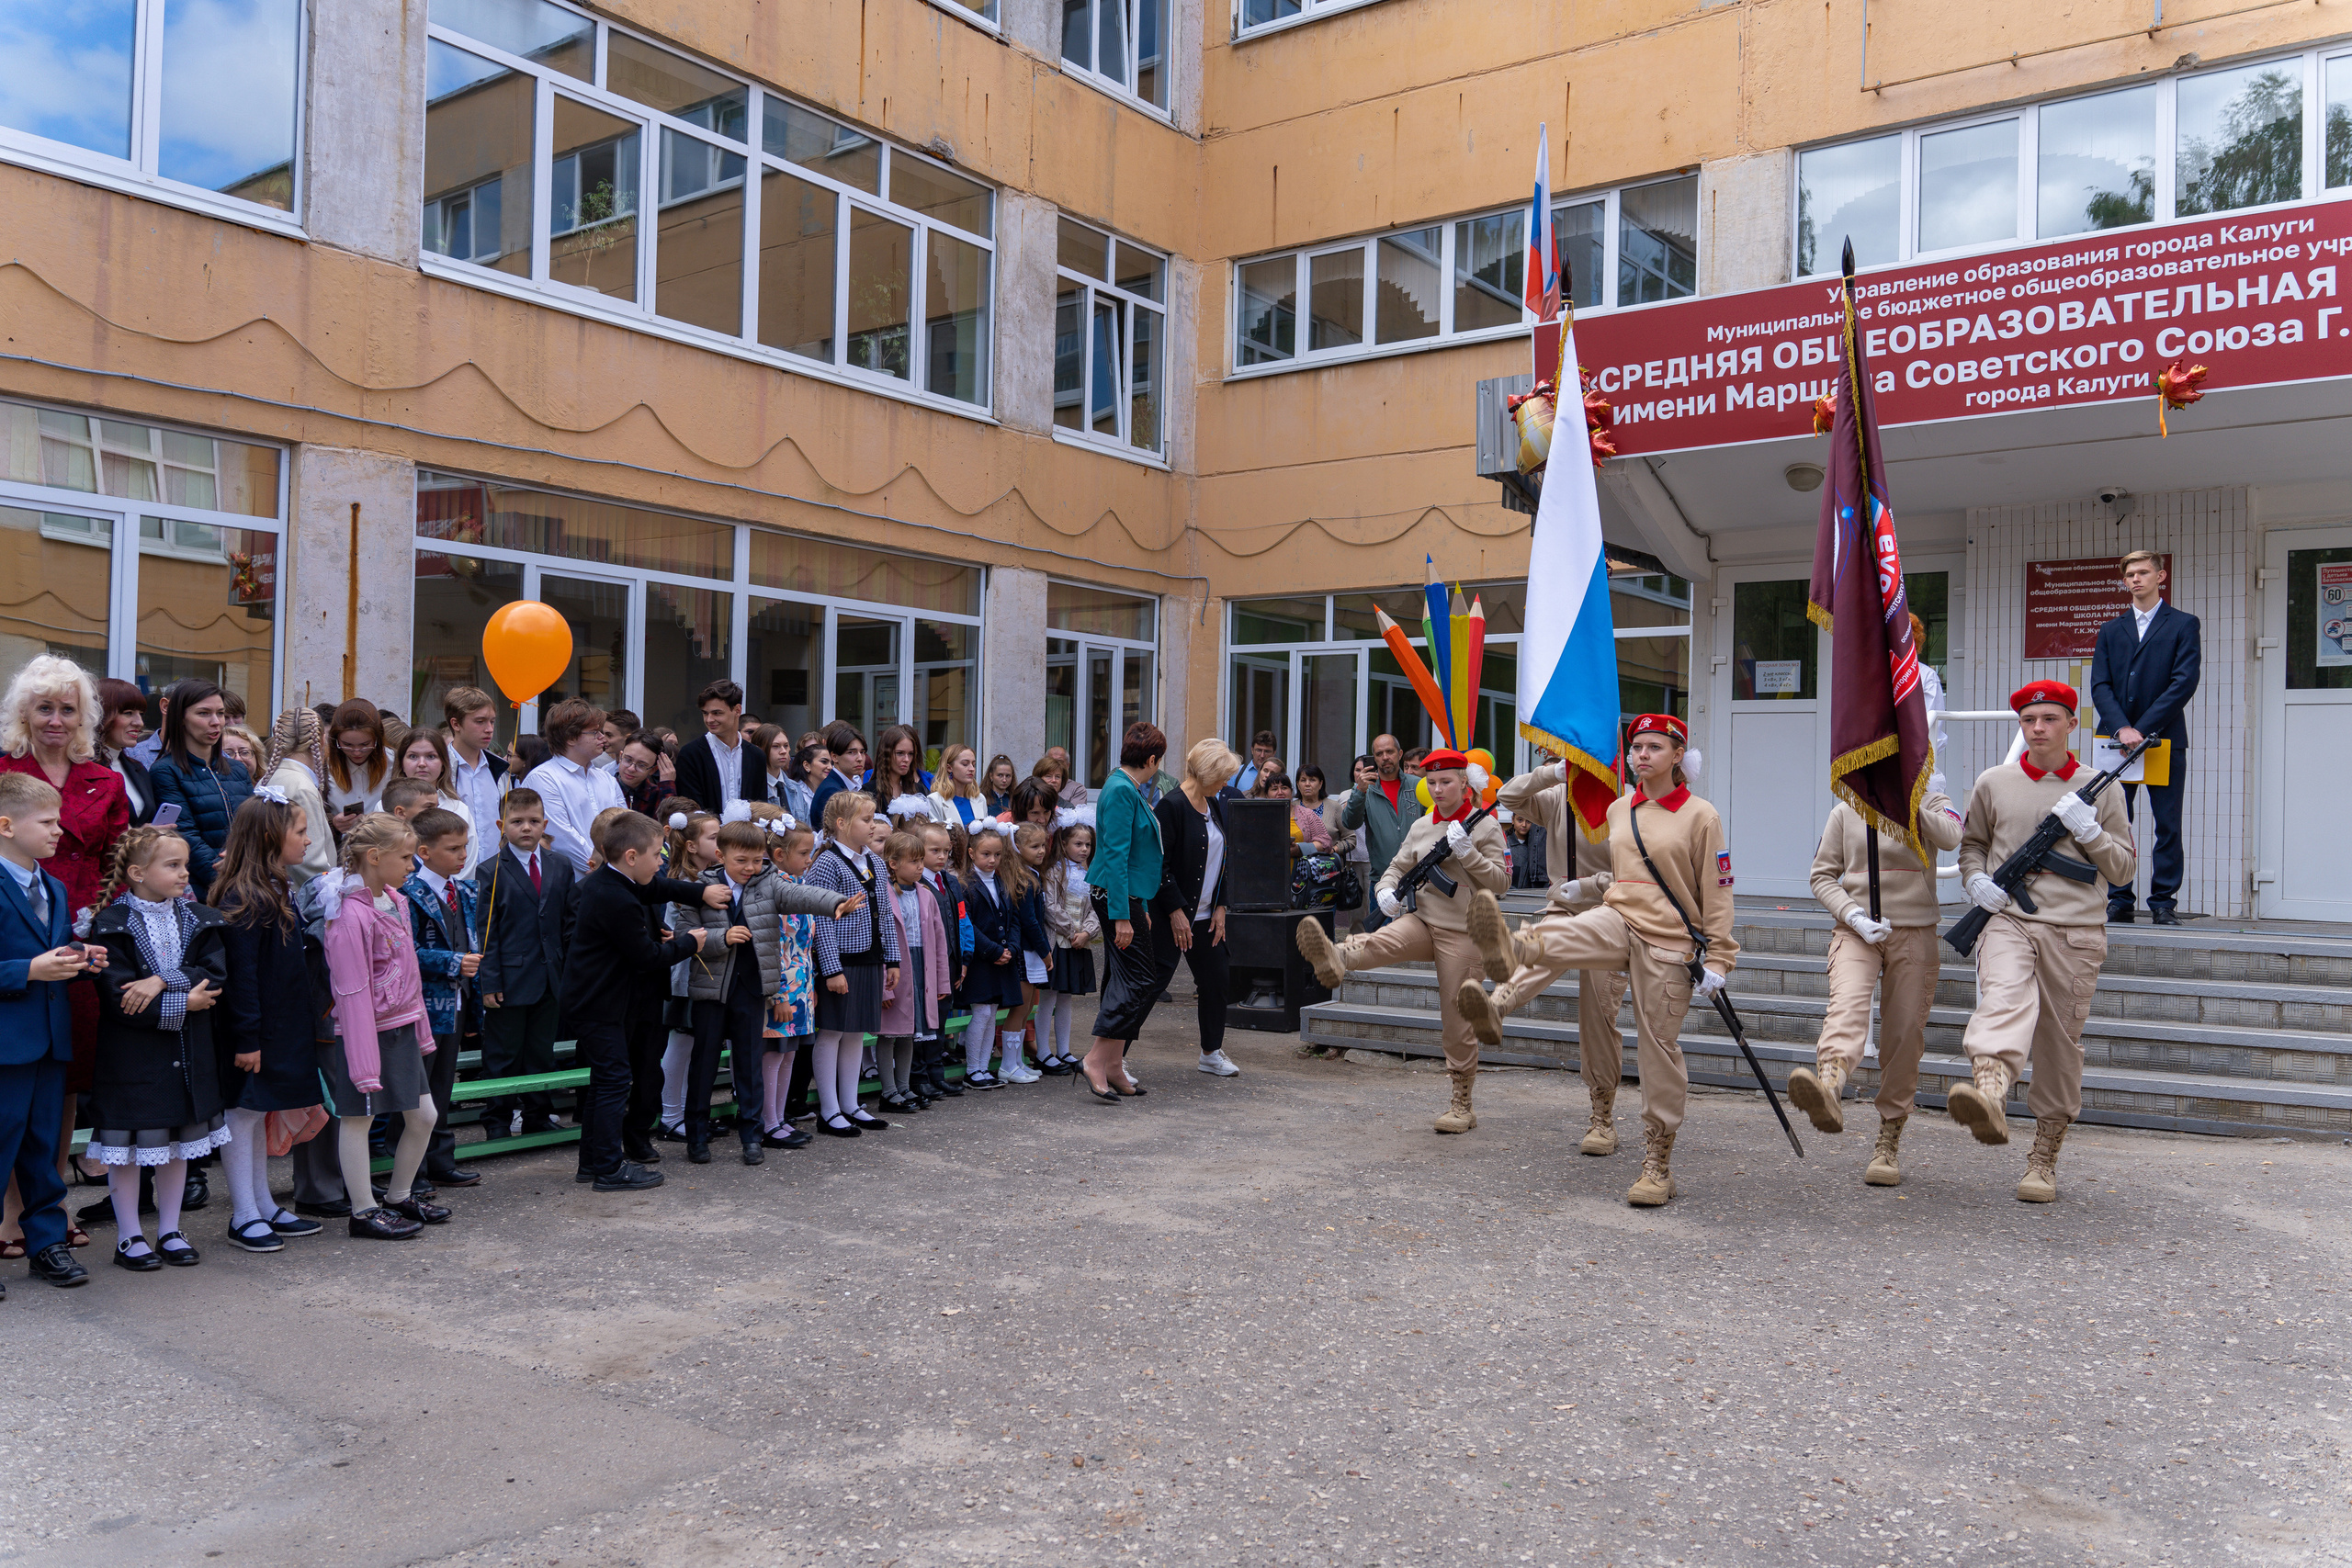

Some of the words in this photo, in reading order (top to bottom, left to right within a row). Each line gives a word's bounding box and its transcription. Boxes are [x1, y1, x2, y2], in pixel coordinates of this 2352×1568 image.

[1964, 247, 2119, 286] образования
[2125, 232, 2213, 261] города
[2221, 218, 2314, 245] Калуги
[1707, 306, 1872, 344] Муниципальне
[1877, 283, 2007, 318] бюджетное
[2011, 243, 2301, 296] общеобразовательное
[1612, 393, 1716, 426] имени
[1725, 370, 1895, 412] Марша
[1905, 338, 2144, 390] Советского
[2155, 318, 2303, 359] Союза
[2318, 306, 2350, 340] Г.
[1965, 382, 2051, 409] города
[2057, 372, 2150, 398] Калуги
[2073, 563, 2114, 571] образования
[2044, 580, 2105, 589] Муниципальное
[2030, 586, 2117, 596] общеобразовательное
[2328, 589, 2341, 601] 60
[2059, 620, 2092, 628] Маршала
